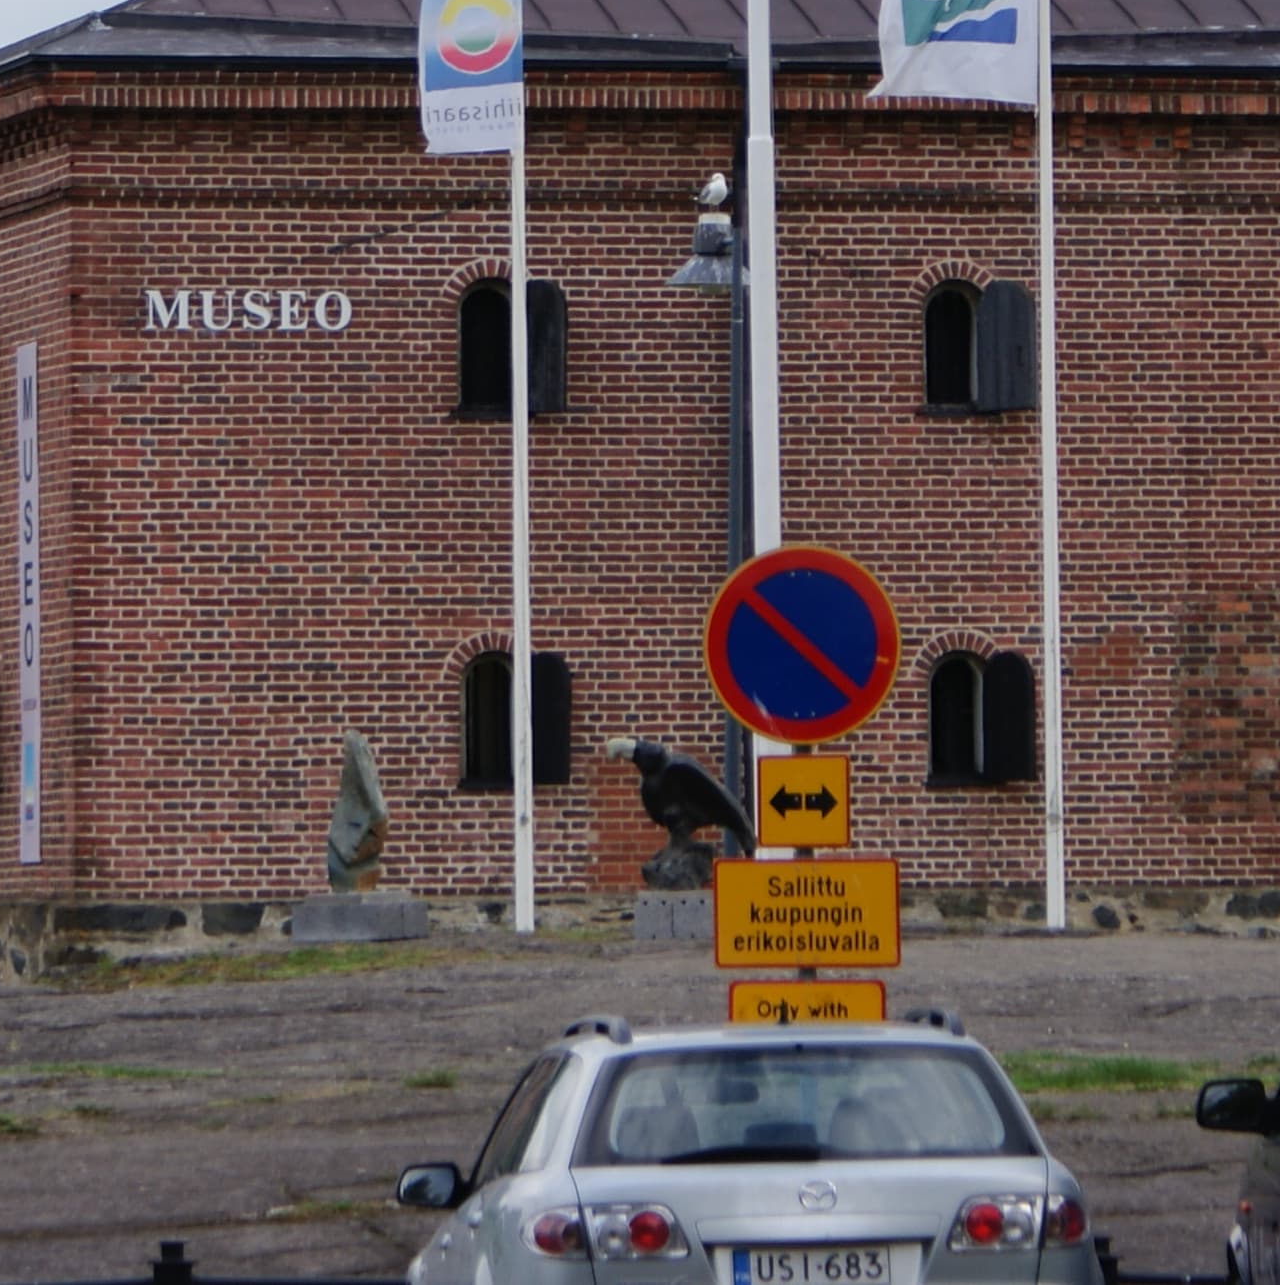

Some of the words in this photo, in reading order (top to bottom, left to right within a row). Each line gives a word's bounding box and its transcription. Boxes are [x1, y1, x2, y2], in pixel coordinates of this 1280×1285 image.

[144, 290, 352, 331] MUSEO
[22, 375, 35, 669] MUSEO
[768, 875, 846, 897] Sallittu
[750, 902, 863, 926] kaupungin
[734, 930, 880, 952] erikoisluvalla
[757, 1000, 799, 1021] Ony
[808, 1002, 848, 1019] with
